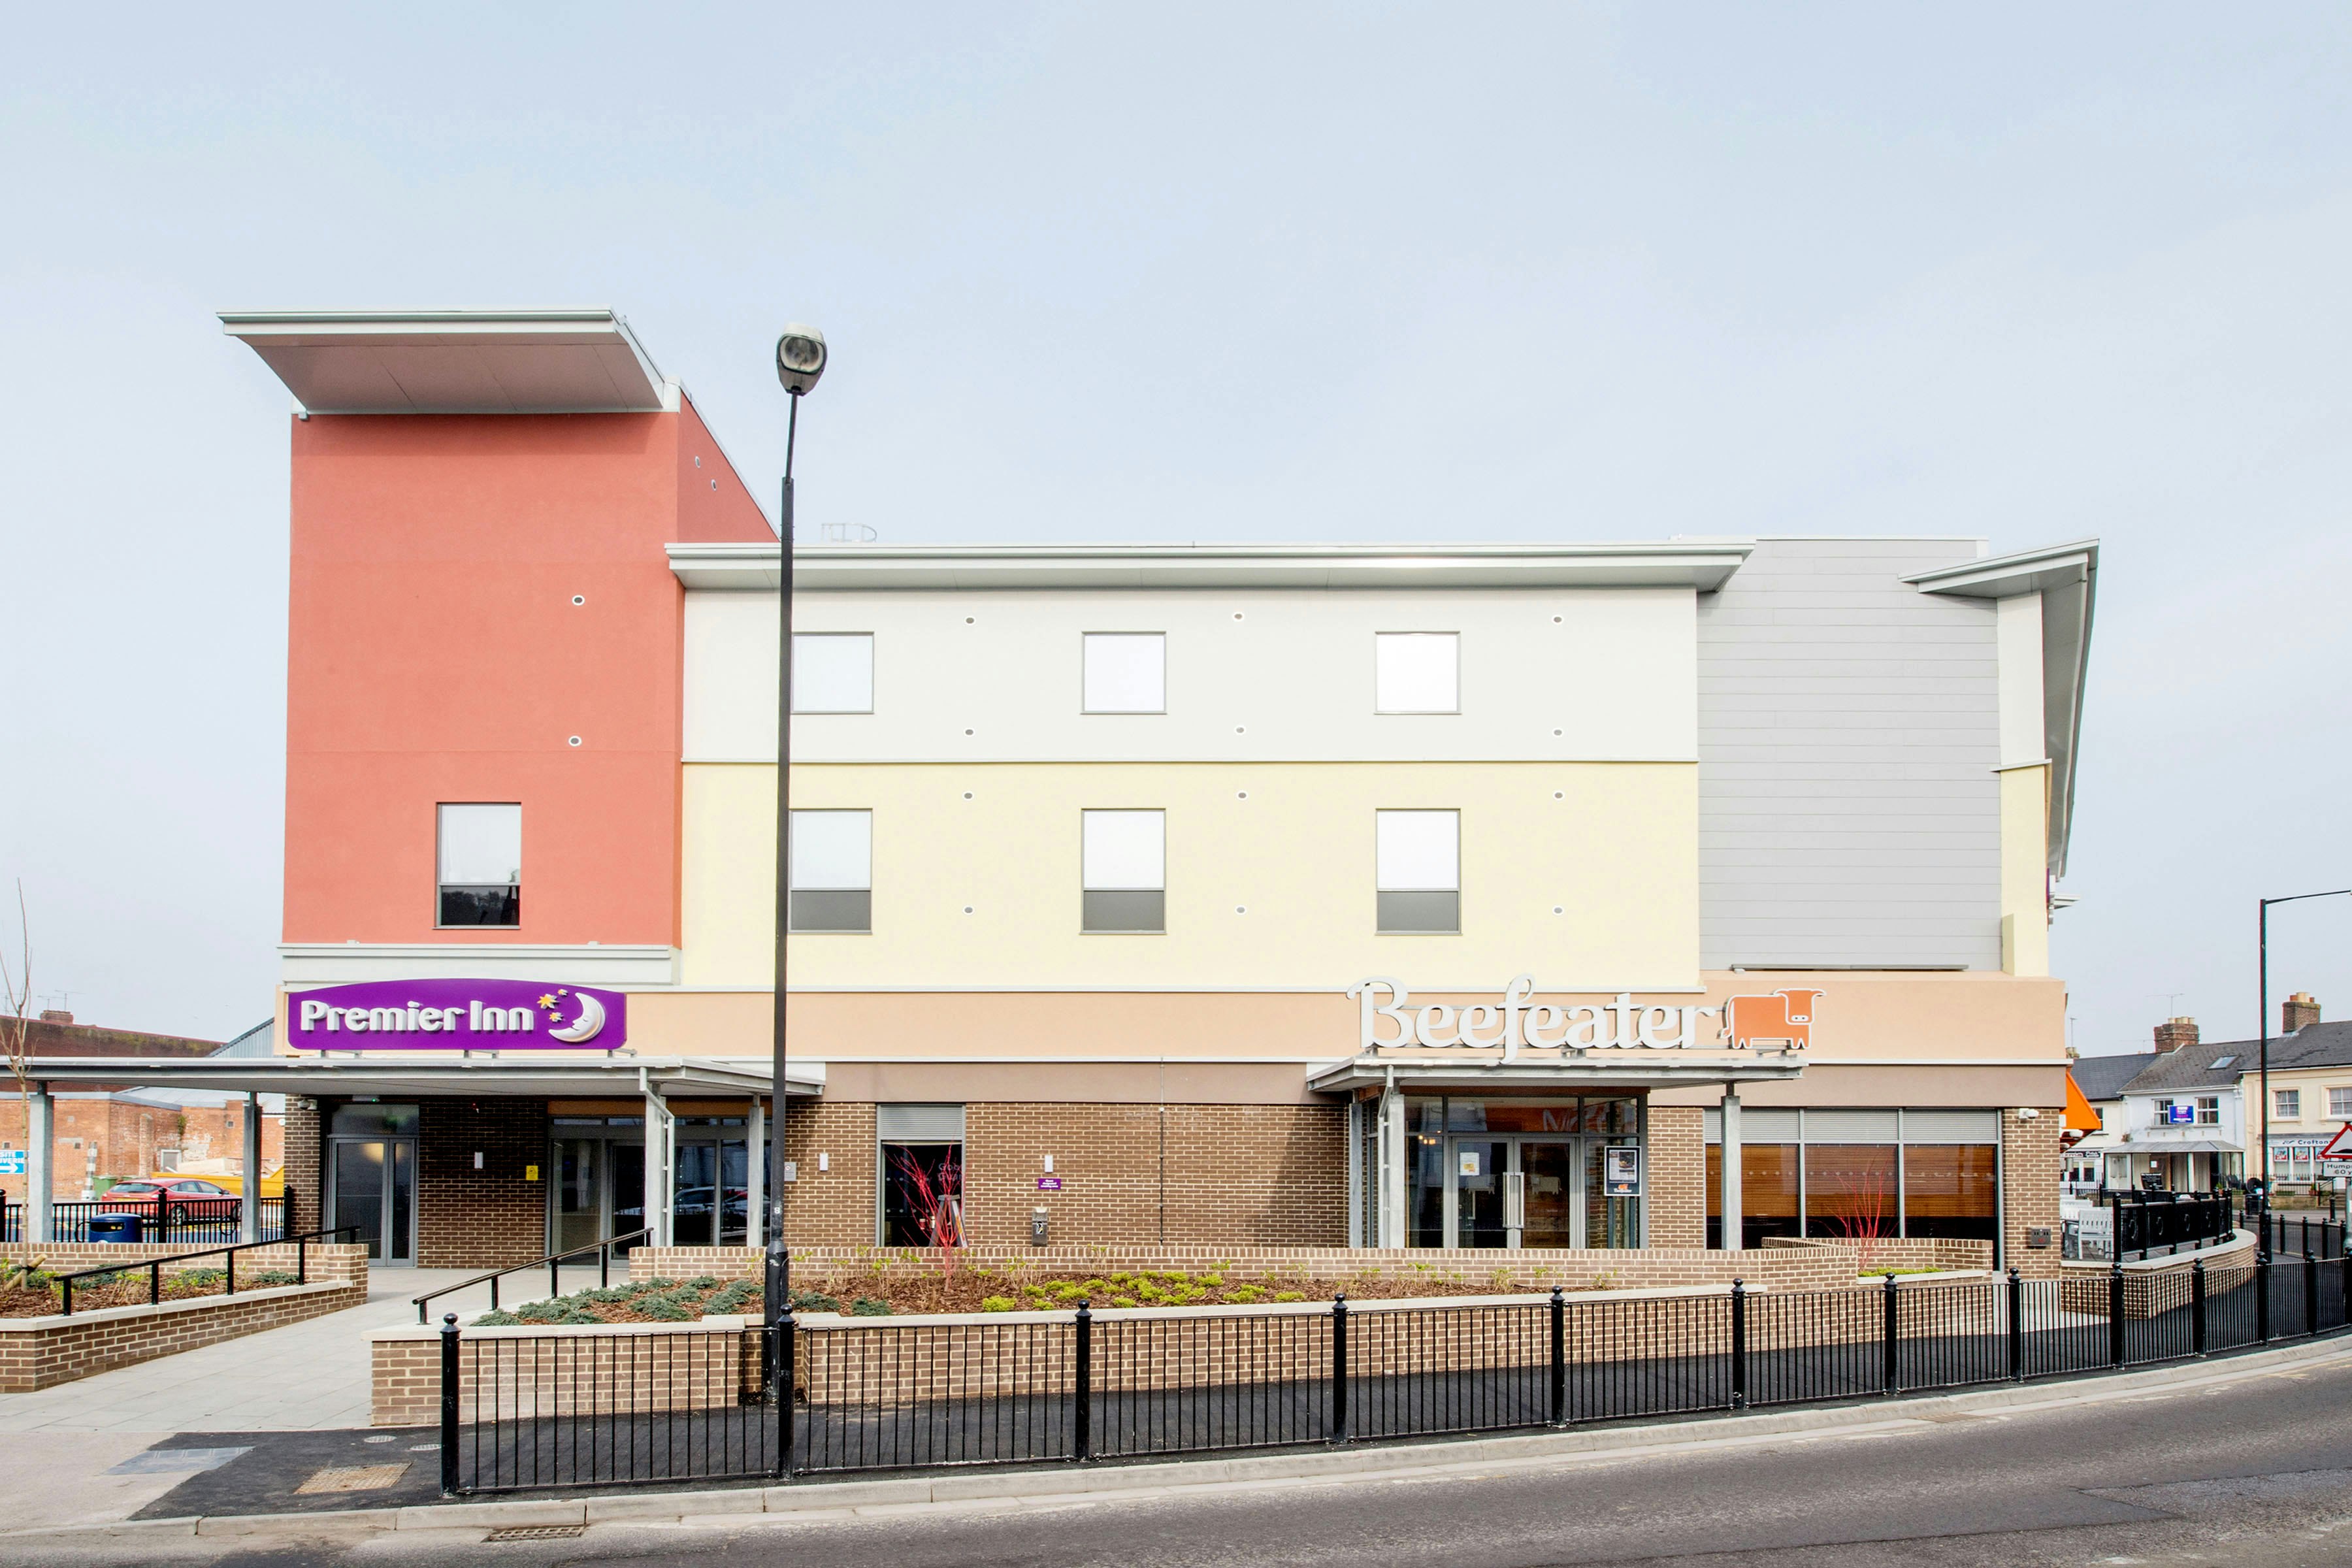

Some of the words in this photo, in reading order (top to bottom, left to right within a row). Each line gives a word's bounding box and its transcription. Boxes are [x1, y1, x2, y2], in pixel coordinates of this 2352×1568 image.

[300, 1000, 465, 1031] Premier
[470, 1000, 534, 1031] Inn
[1346, 973, 1716, 1064] Beefeater
